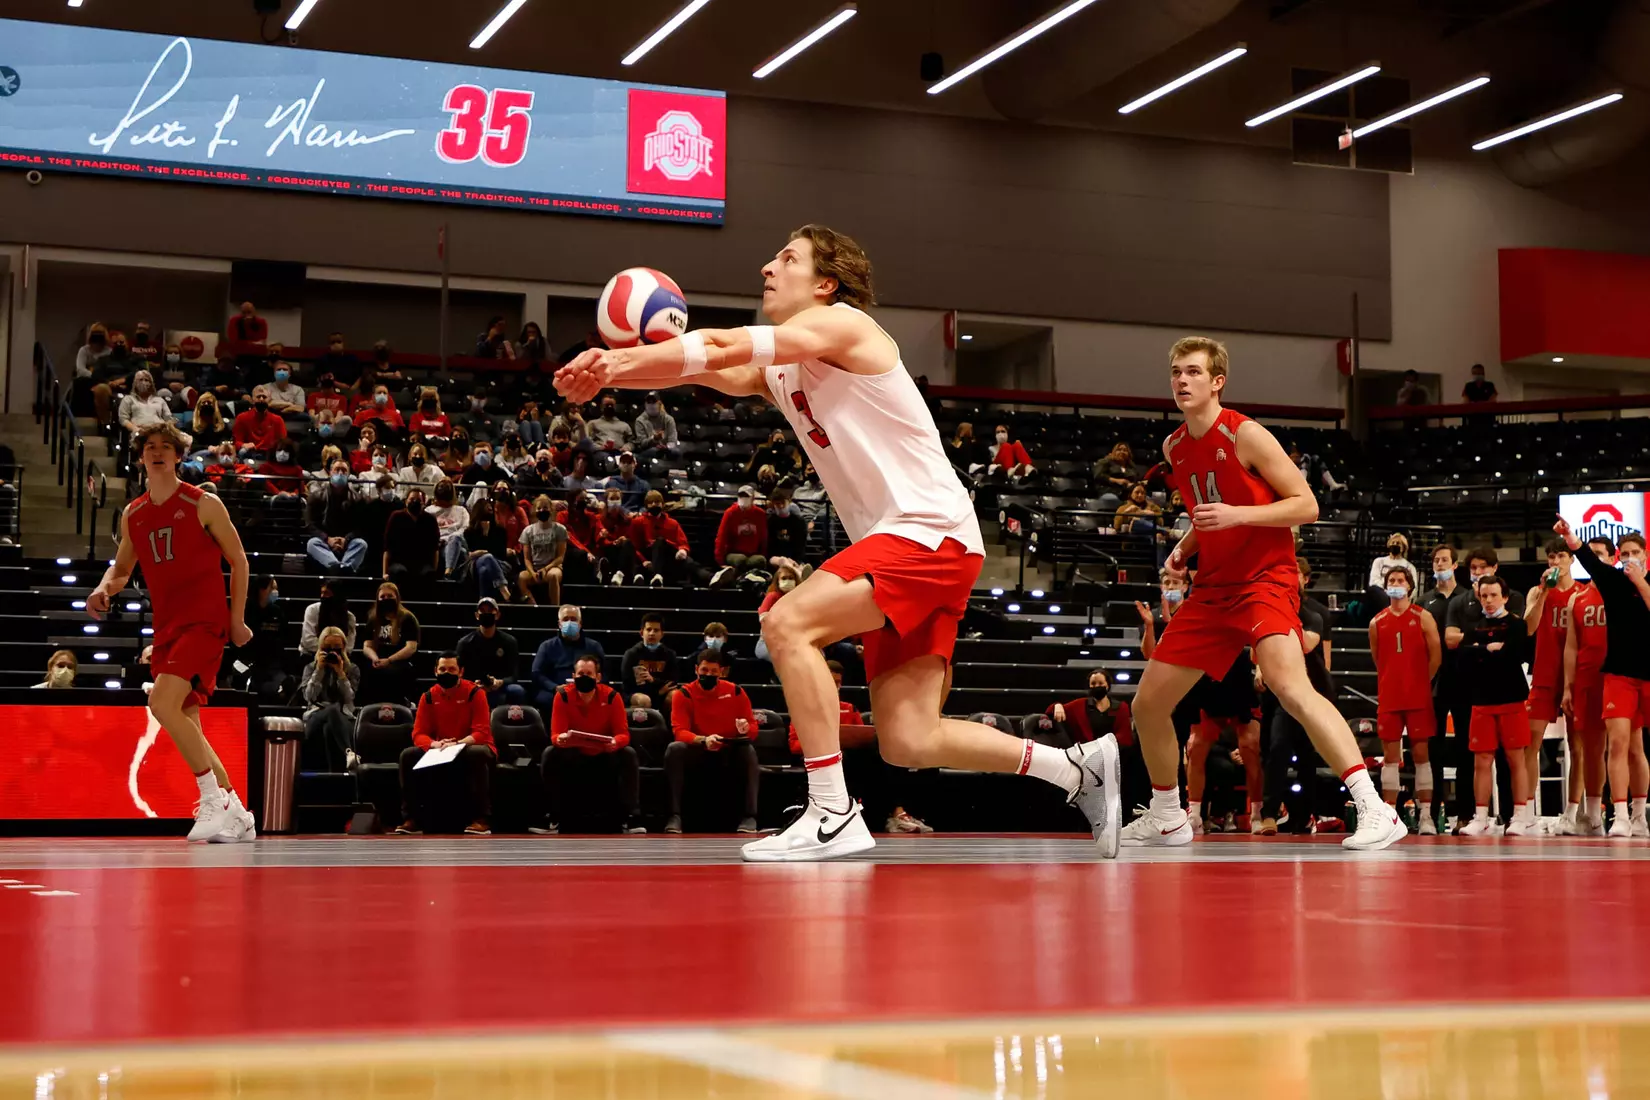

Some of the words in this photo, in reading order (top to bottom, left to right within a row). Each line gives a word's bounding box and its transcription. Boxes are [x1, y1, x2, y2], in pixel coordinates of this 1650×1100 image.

[435, 84, 536, 168] 35
[48, 157, 73, 167] THE
[75, 159, 144, 172] TRADITION.
[146, 165, 170, 174] THE
[172, 167, 251, 181] EXCELLENCE.
[366, 183, 389, 192] THE
[391, 185, 438, 197] PEOPLE.
[440, 190, 463, 199] THE
[464, 192, 526, 204] TRADITION.
[529, 197, 550, 206] THE
[552, 199, 622, 212] EXCELLENCE.
[790, 390, 831, 449] 3
[1189, 470, 1223, 505] 14
[148, 526, 174, 563] 17
[1551, 606, 1568, 628] 18
[1583, 604, 1606, 627] 20
[1396, 631, 1402, 653] 1
